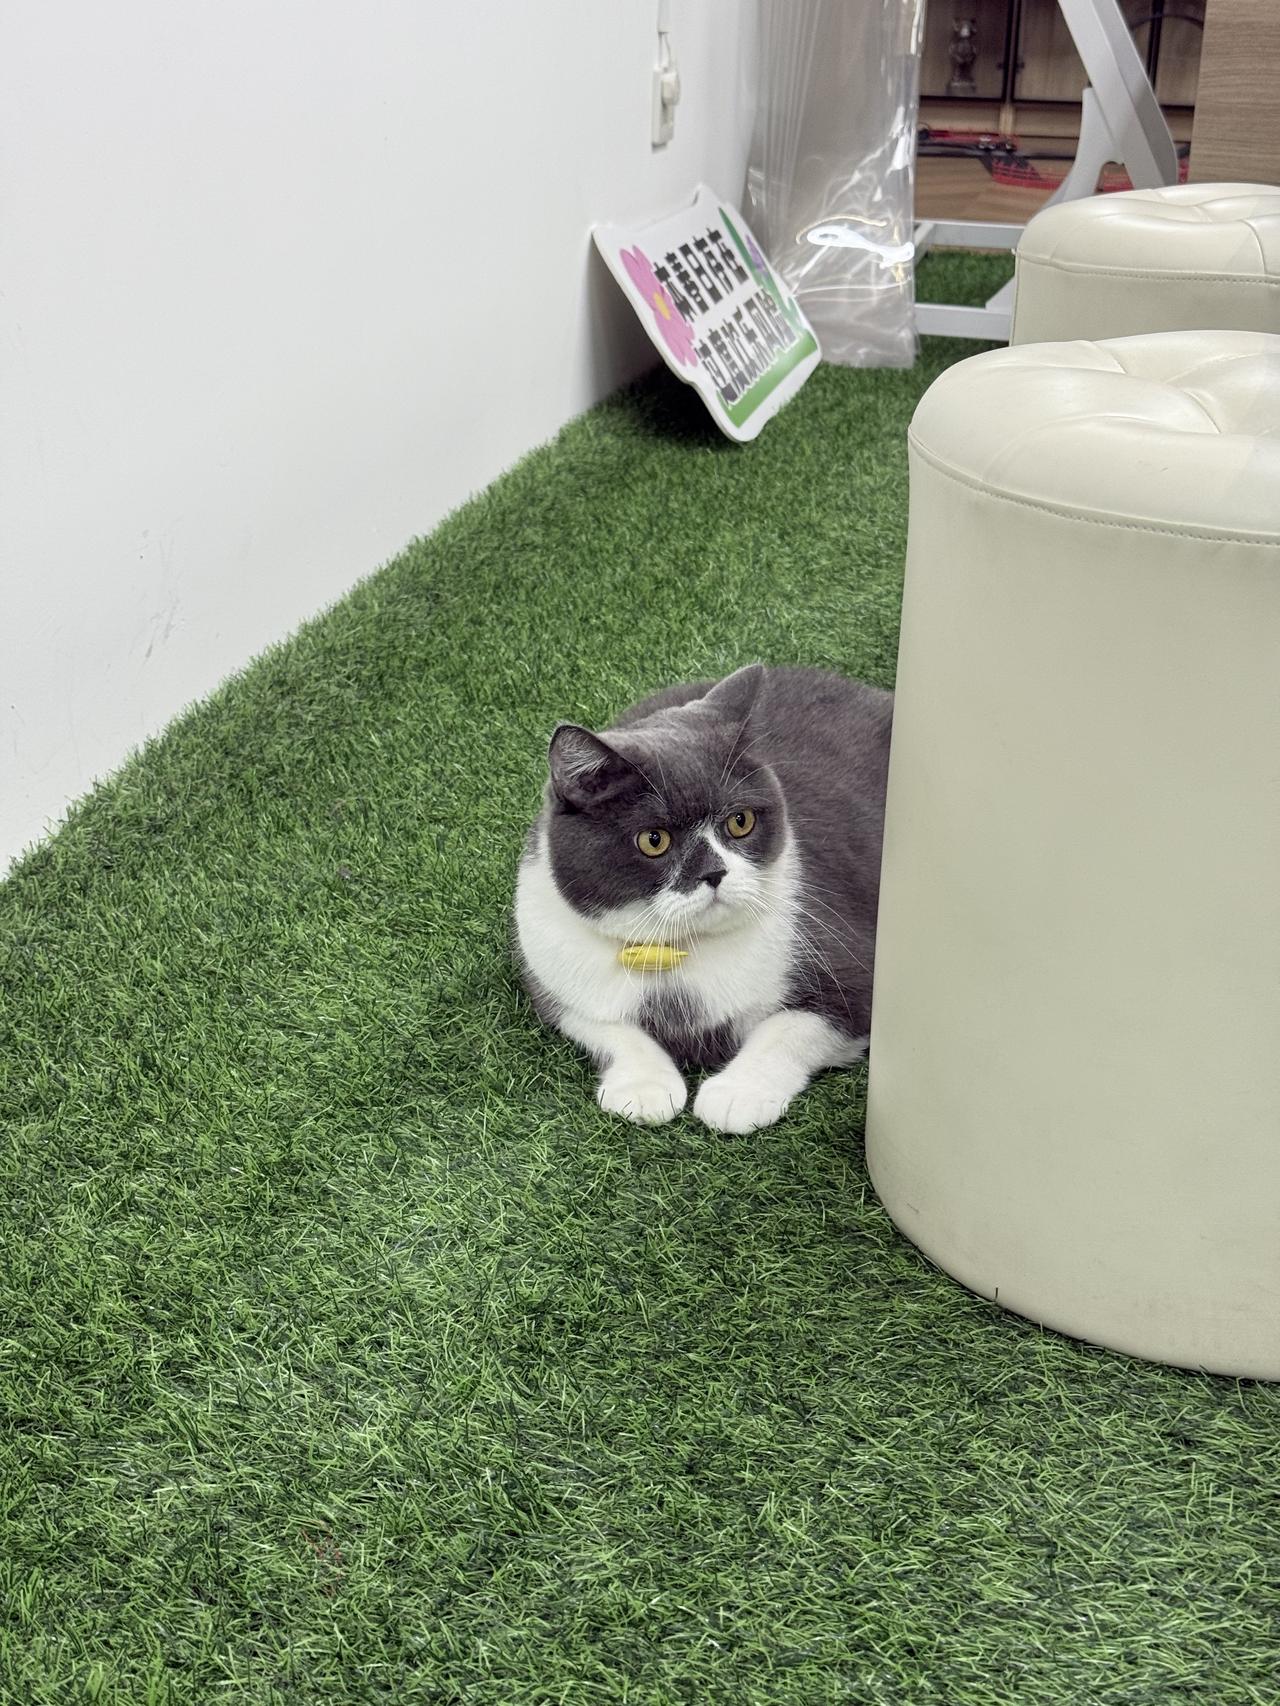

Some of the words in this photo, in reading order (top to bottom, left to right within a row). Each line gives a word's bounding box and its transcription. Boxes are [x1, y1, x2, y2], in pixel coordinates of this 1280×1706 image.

[653, 227, 749, 323] 本春日存在
